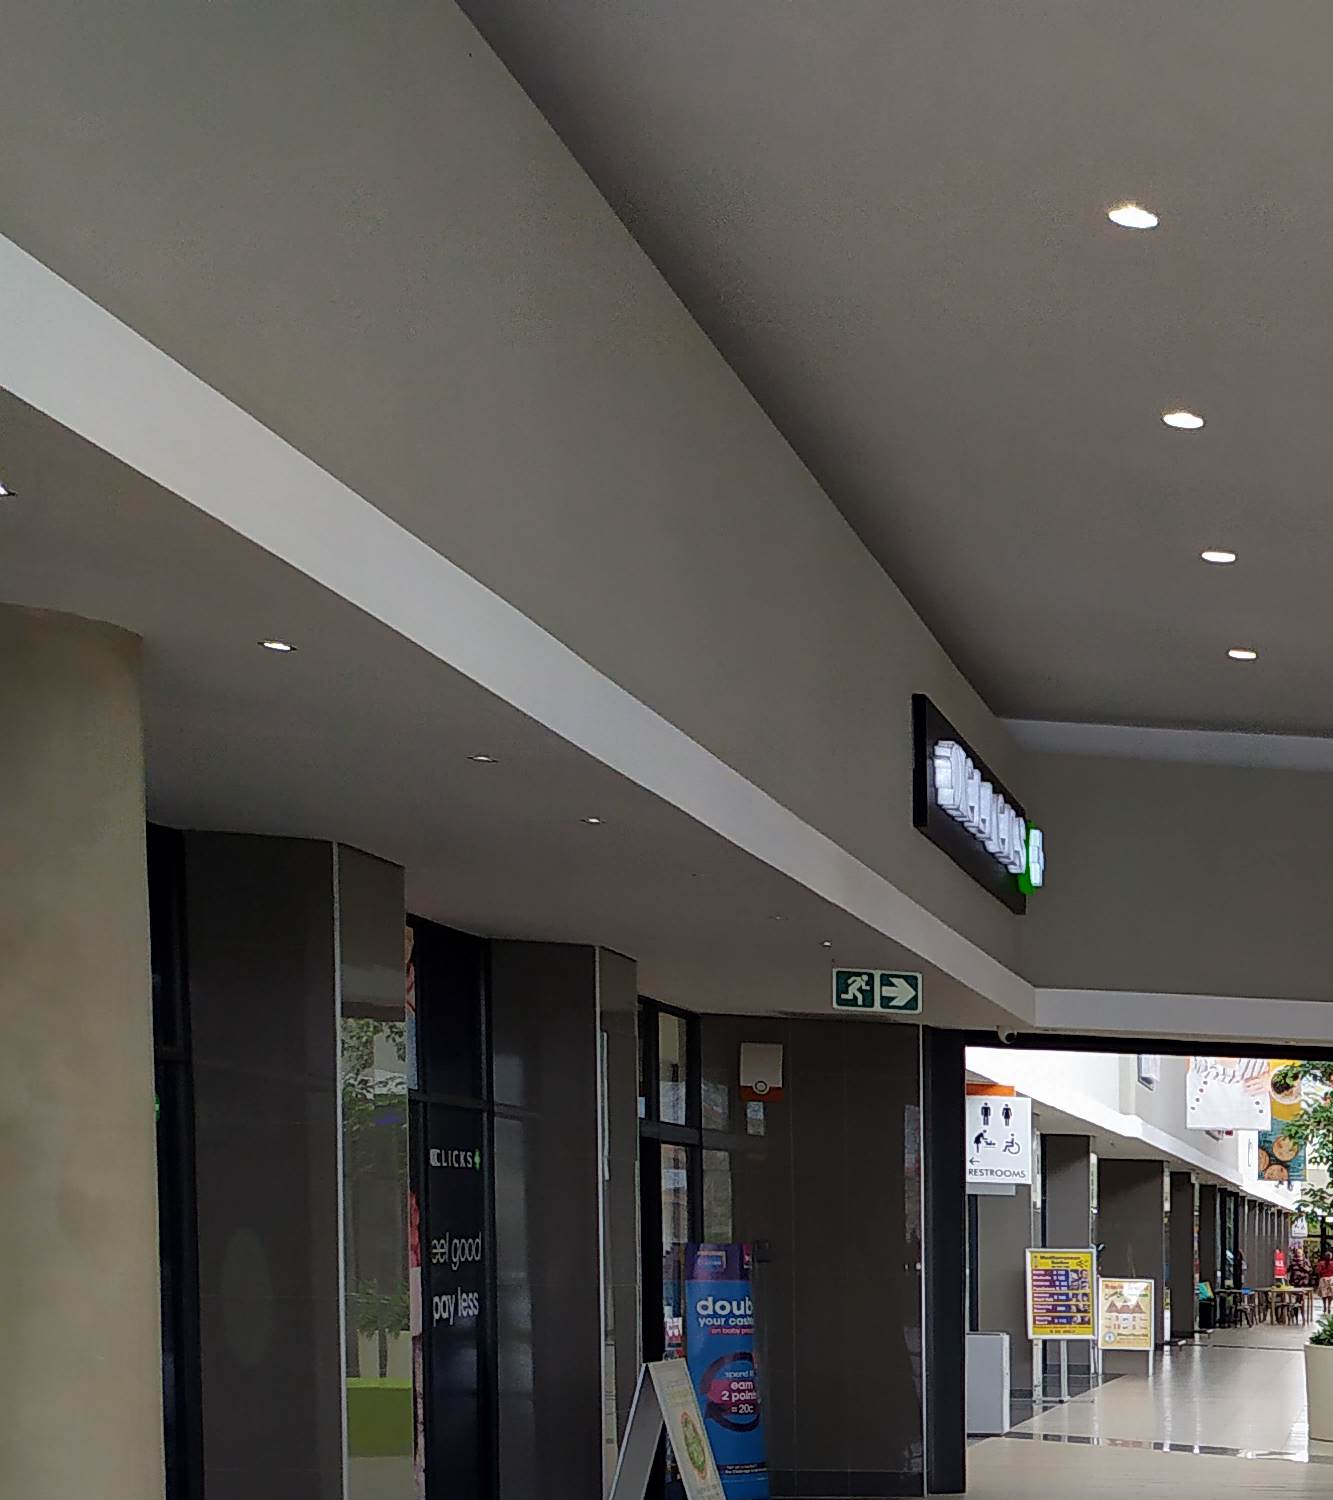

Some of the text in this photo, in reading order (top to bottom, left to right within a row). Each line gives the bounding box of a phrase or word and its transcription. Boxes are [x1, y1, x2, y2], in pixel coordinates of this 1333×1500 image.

[968, 1168, 1026, 1178] RESTROOMS
[451, 1232, 482, 1270] good
[433, 1286, 480, 1327] pay less
[696, 1296, 753, 1315] doub
[699, 1317, 725, 1328] your
[721, 1391, 730, 1401] 2
